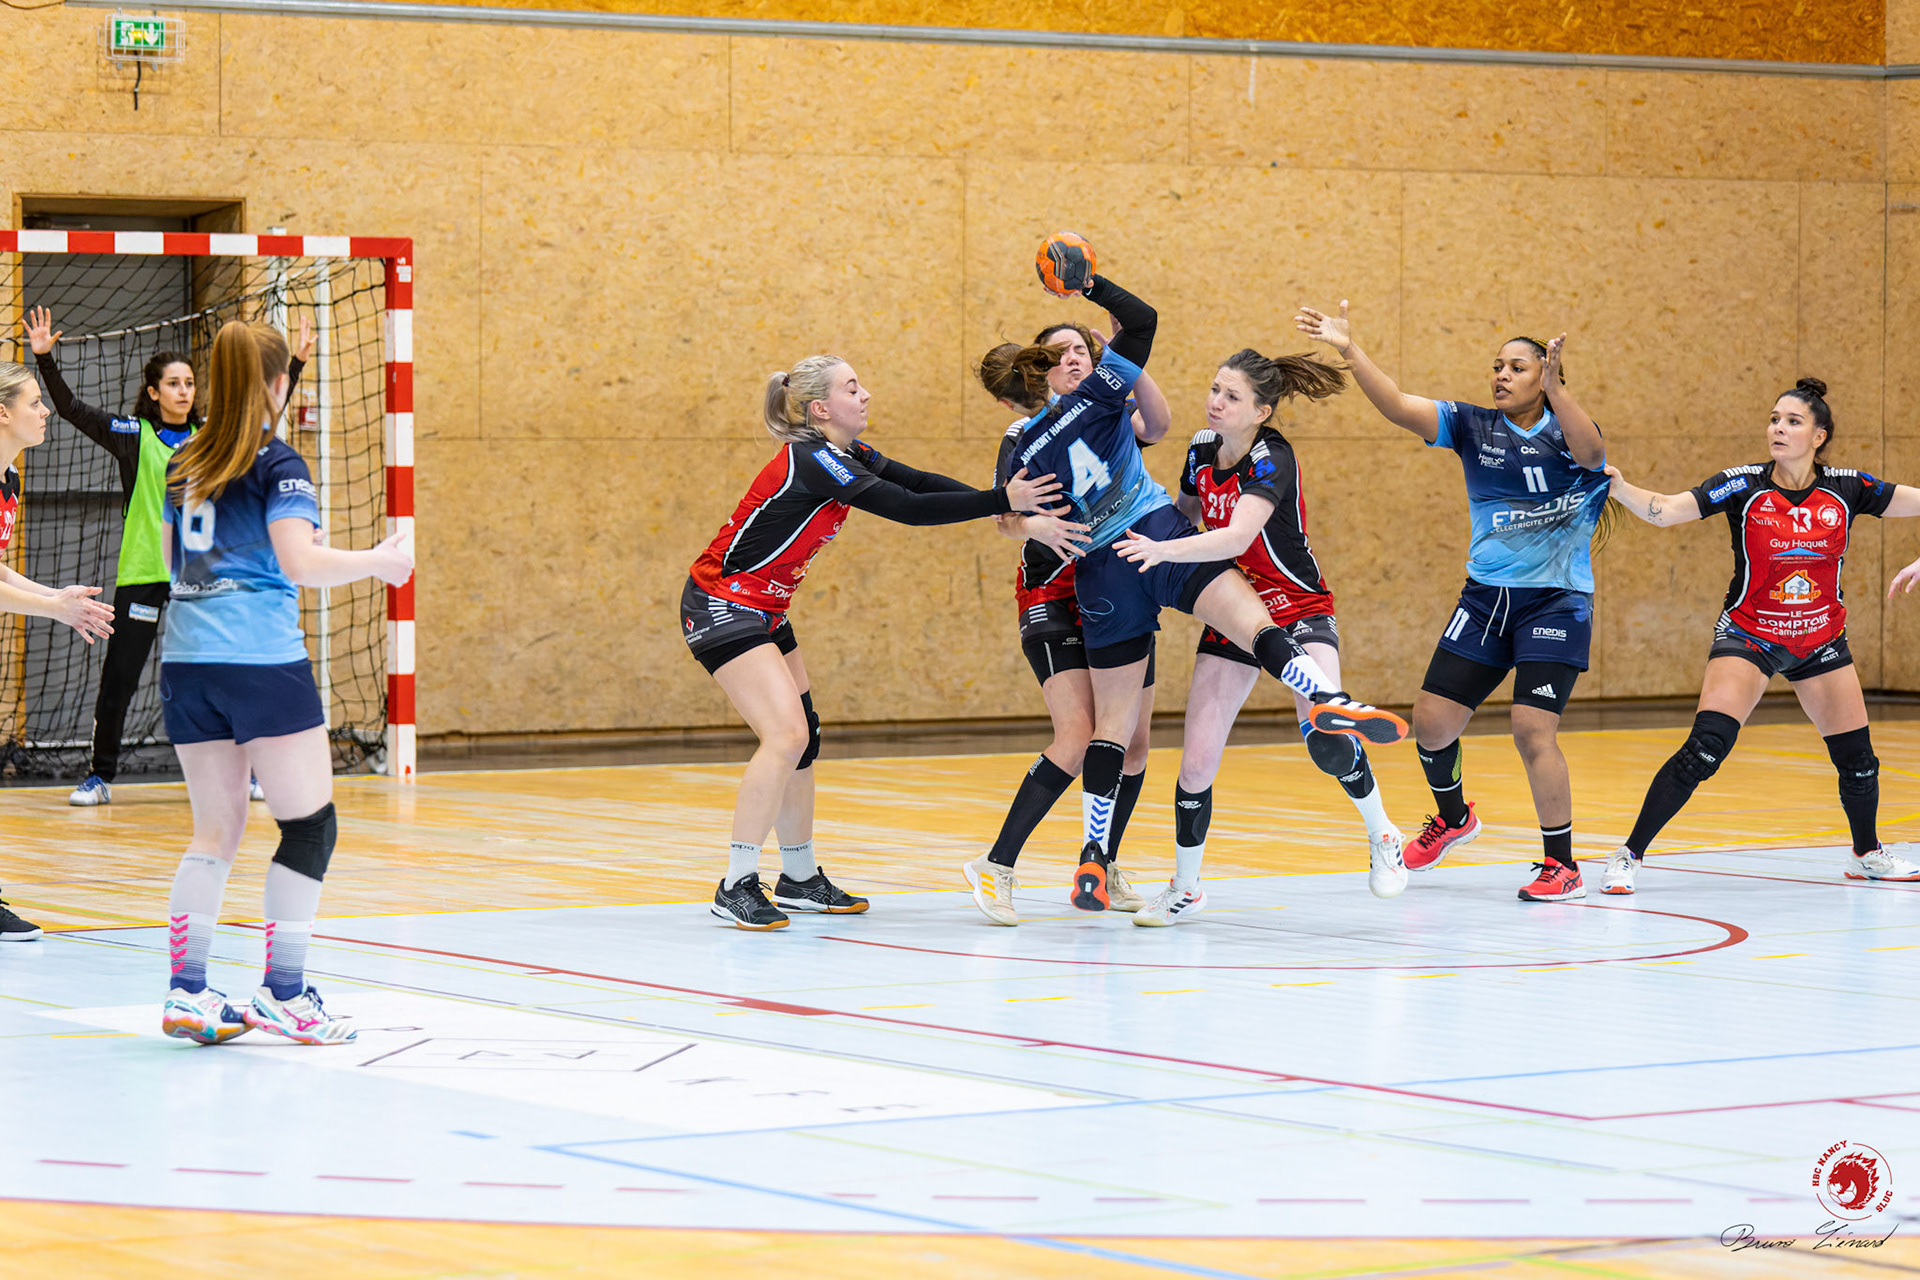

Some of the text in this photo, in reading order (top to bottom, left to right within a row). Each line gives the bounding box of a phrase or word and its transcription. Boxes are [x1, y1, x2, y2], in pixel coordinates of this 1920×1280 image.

[1048, 402, 1087, 437] HANDBALL
[1068, 436, 1112, 498] 4
[1522, 466, 1549, 493] 11
[1207, 491, 1228, 520] 21
[1544, 515, 1555, 524] EN
[1786, 506, 1812, 533] 13
[1769, 538, 1828, 550] Guy Hoquet
[1291, 627, 1313, 638] SELECT
[1443, 607, 1471, 641] 11
[1820, 652, 1840, 663] SELECT
[1531, 688, 1557, 699] adidas
